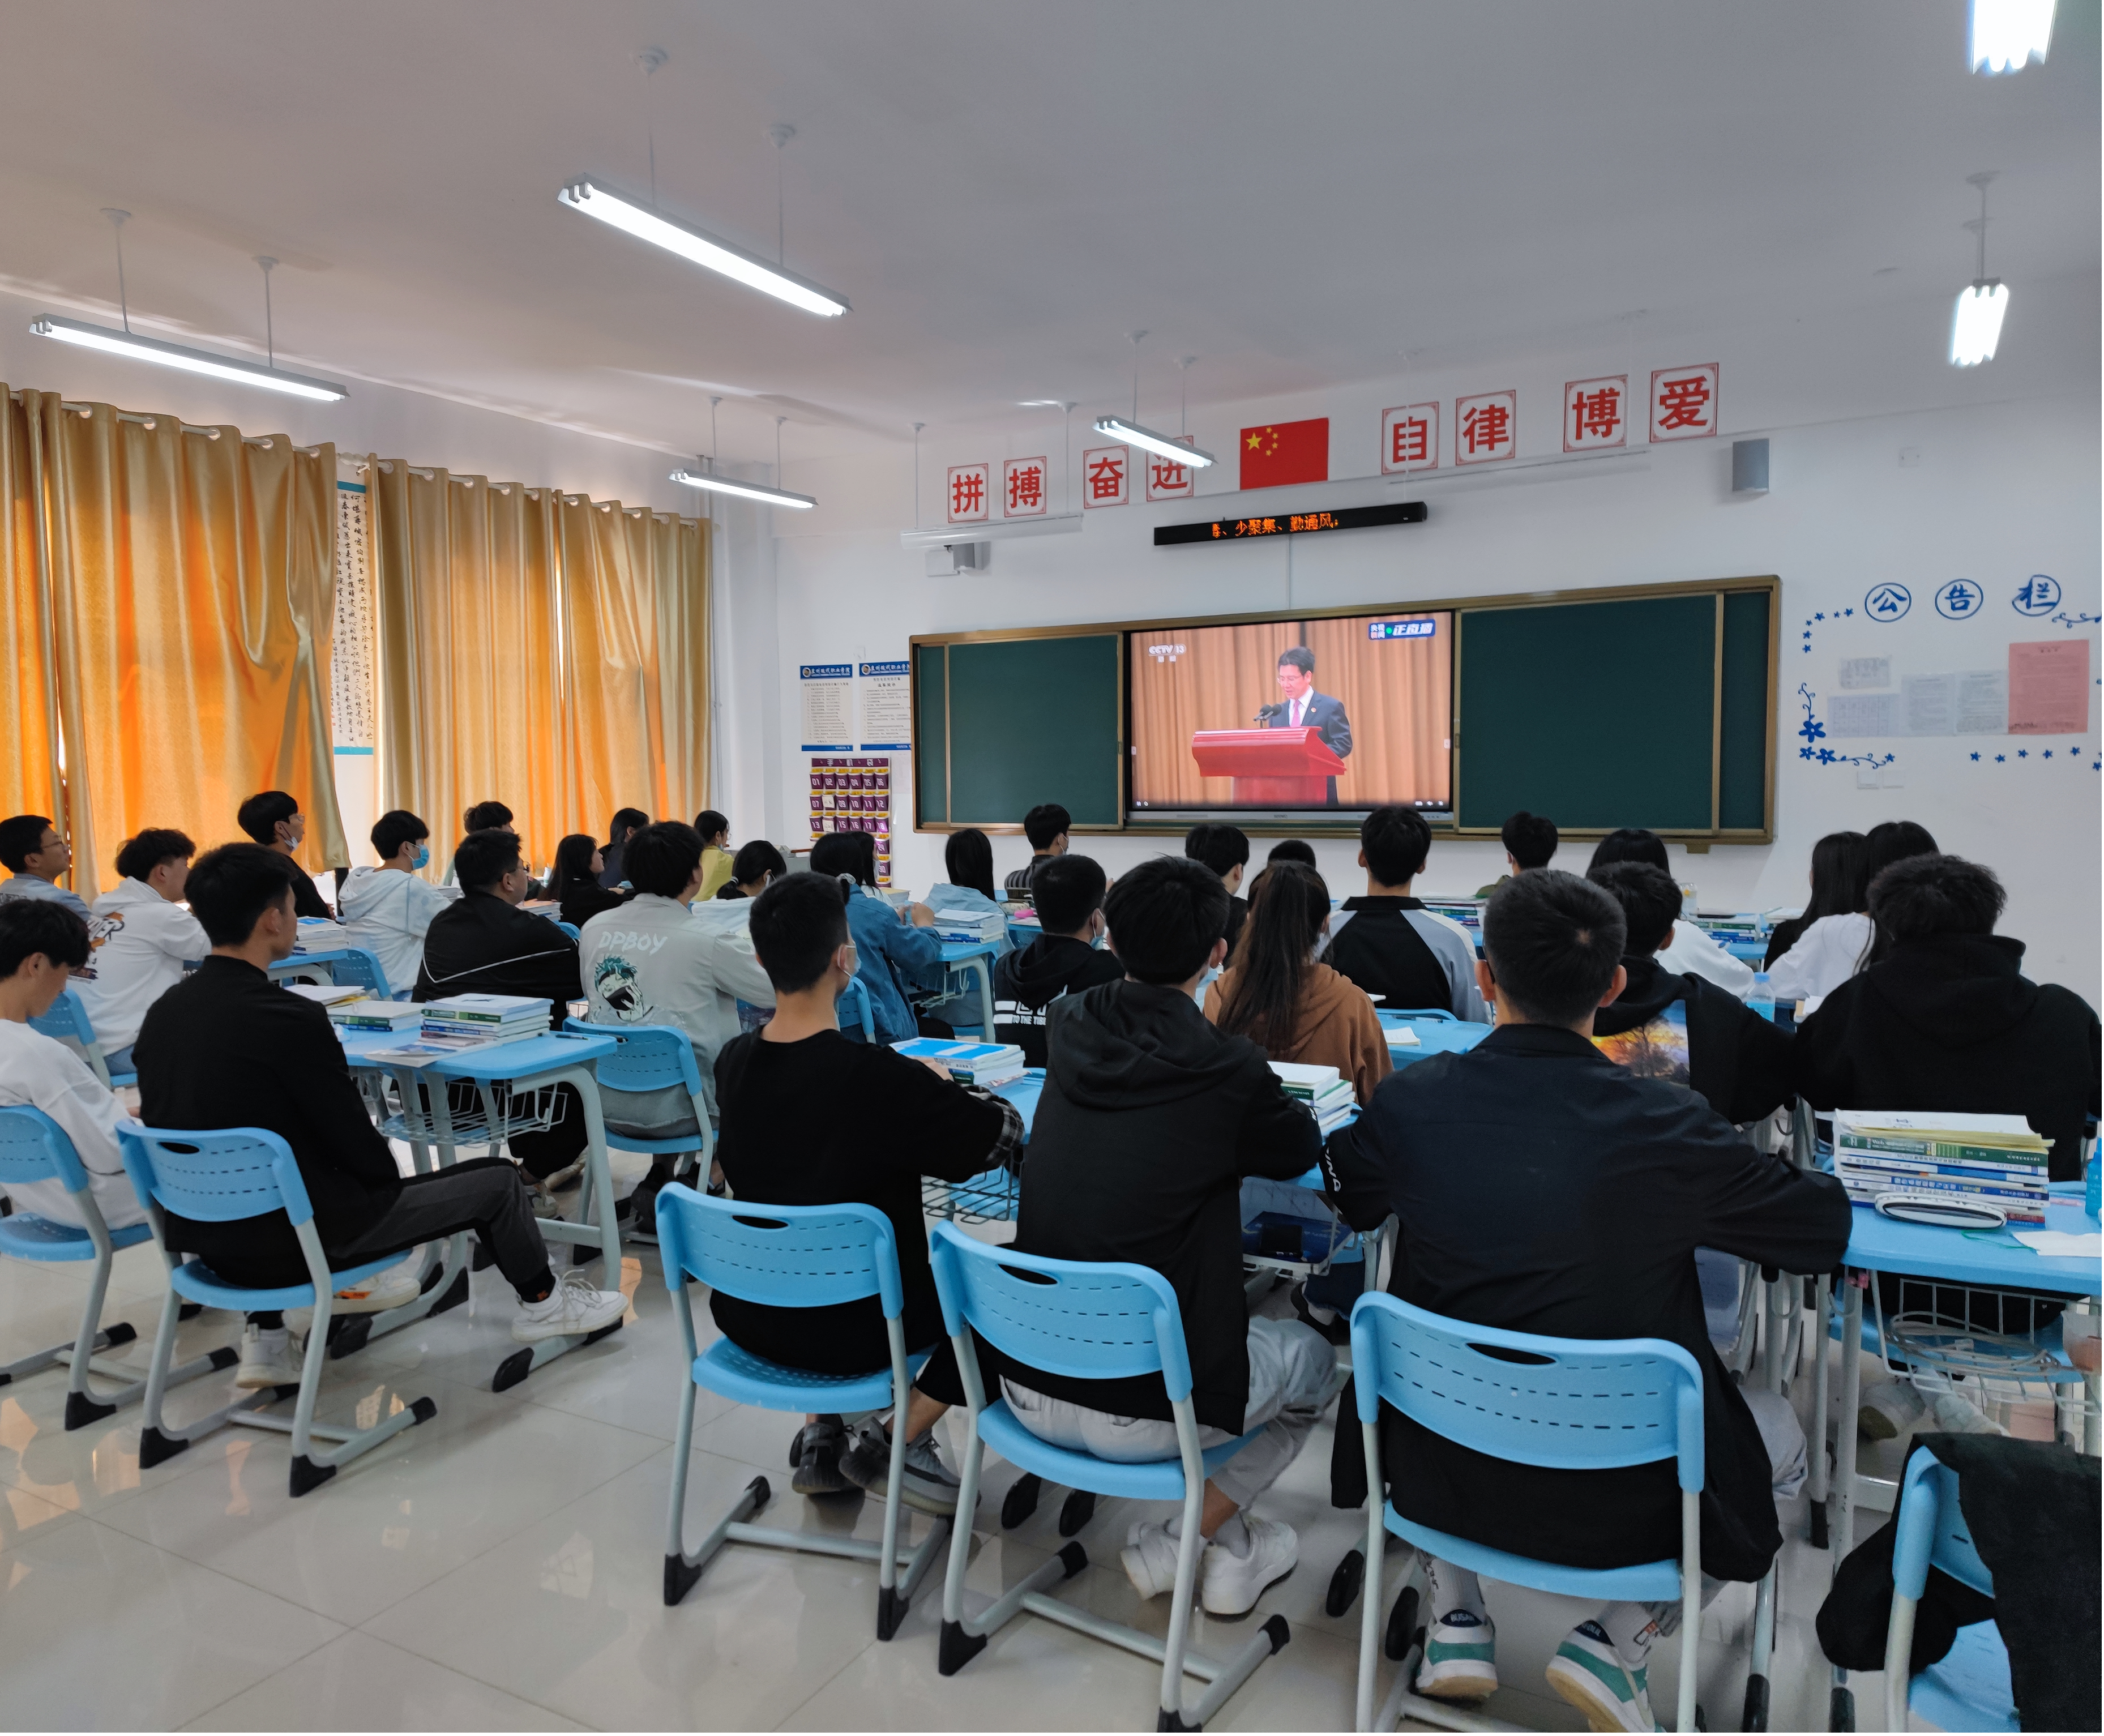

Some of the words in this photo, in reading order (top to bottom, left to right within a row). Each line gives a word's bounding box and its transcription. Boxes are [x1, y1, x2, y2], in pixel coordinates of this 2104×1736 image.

[953, 468, 1041, 512] 拼搏
[1089, 455, 1187, 499] 奋进
[1393, 404, 1508, 463] 自律
[1572, 376, 1710, 439] 博爱
[1872, 577, 2058, 613] 公告栏
[837, 778, 846, 786] 03
[598, 931, 668, 956] DPBOY
